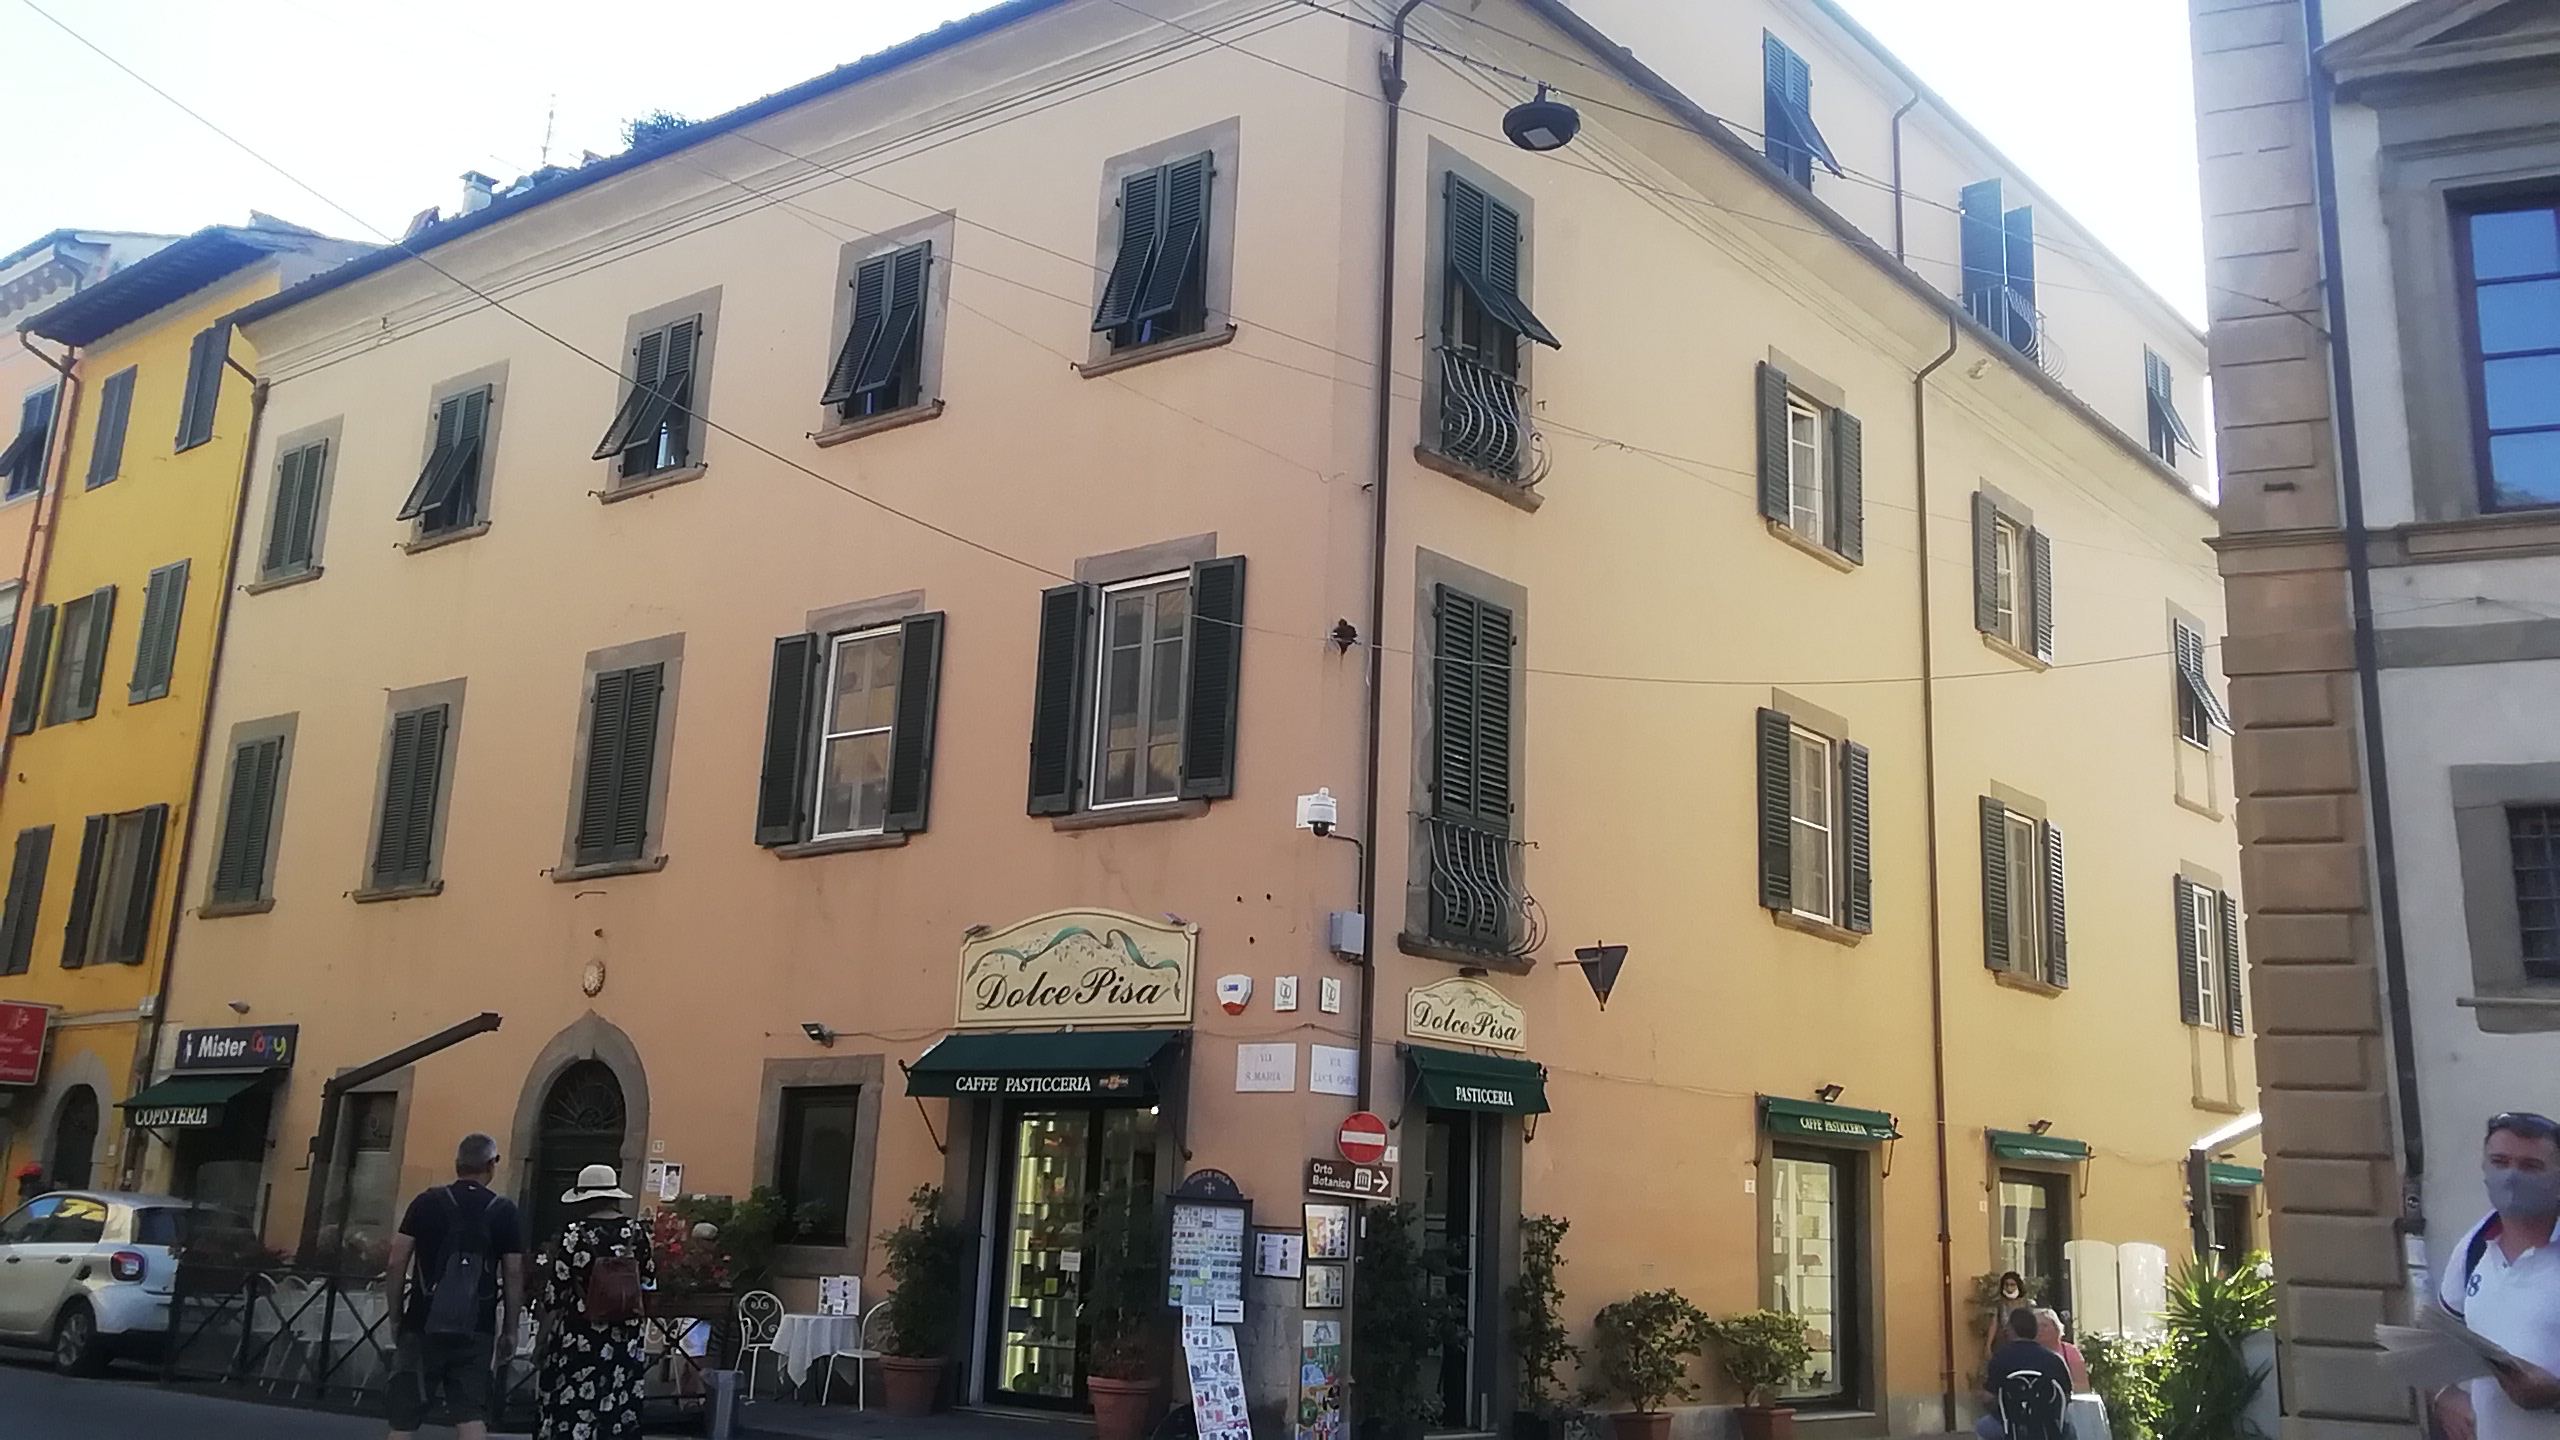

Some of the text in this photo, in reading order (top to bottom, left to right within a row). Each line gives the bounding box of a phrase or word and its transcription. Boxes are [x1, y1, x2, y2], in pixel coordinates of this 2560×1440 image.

[976, 966, 1170, 1011] Dolce Pisa
[1413, 1000, 1521, 1041] Dolce Pisa
[198, 1034, 248, 1058] Mister
[1005, 1076, 1091, 1092] PASTICCERIA
[1455, 1086, 1514, 1106] PASTICCERIA
[135, 1107, 208, 1126] COPISTERIA
[1313, 1162, 1333, 1175] Orto
[1312, 1174, 1352, 1190] Botanico
